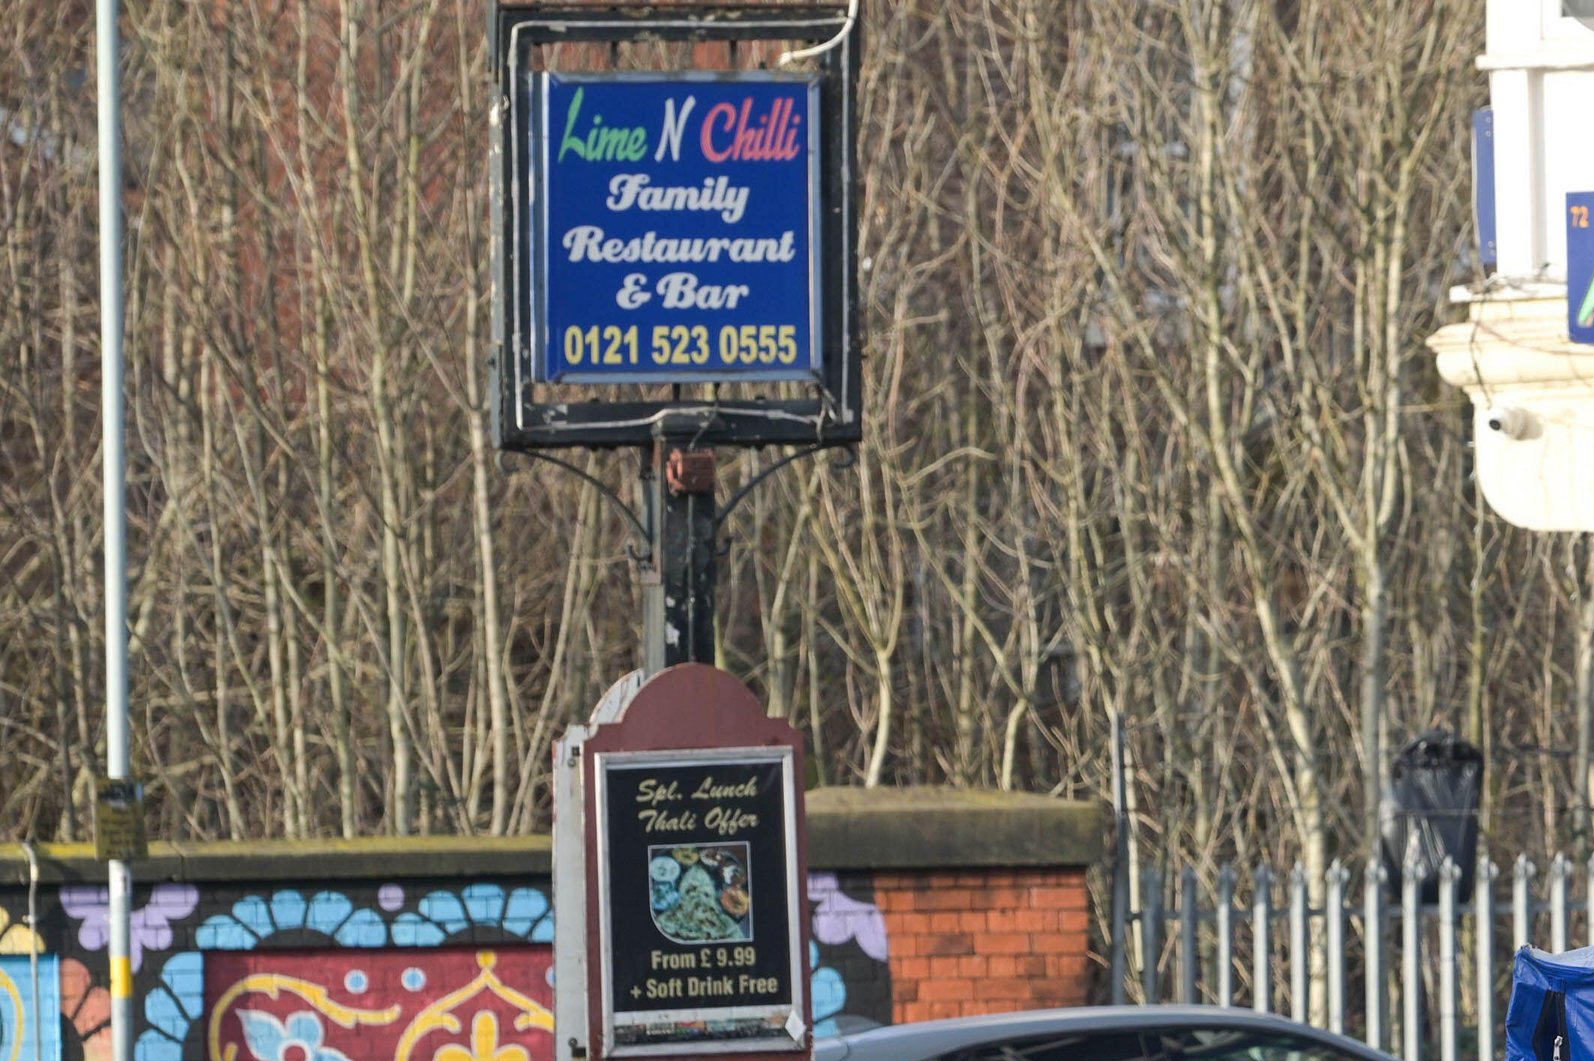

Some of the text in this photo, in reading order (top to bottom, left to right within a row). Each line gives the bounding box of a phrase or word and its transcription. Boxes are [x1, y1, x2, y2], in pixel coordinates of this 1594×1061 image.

[558, 87, 801, 163] Lime N Chilli
[607, 173, 749, 223] Family
[562, 225, 796, 263] Restaurant
[615, 272, 749, 310] & Bar
[564, 325, 798, 364] 0121 523 0555
[636, 776, 758, 803] Spl. Lunch
[638, 806, 759, 834] Thali Offer
[651, 946, 756, 969] From £ 9.99
[630, 975, 778, 999] + Soft Drink Free
